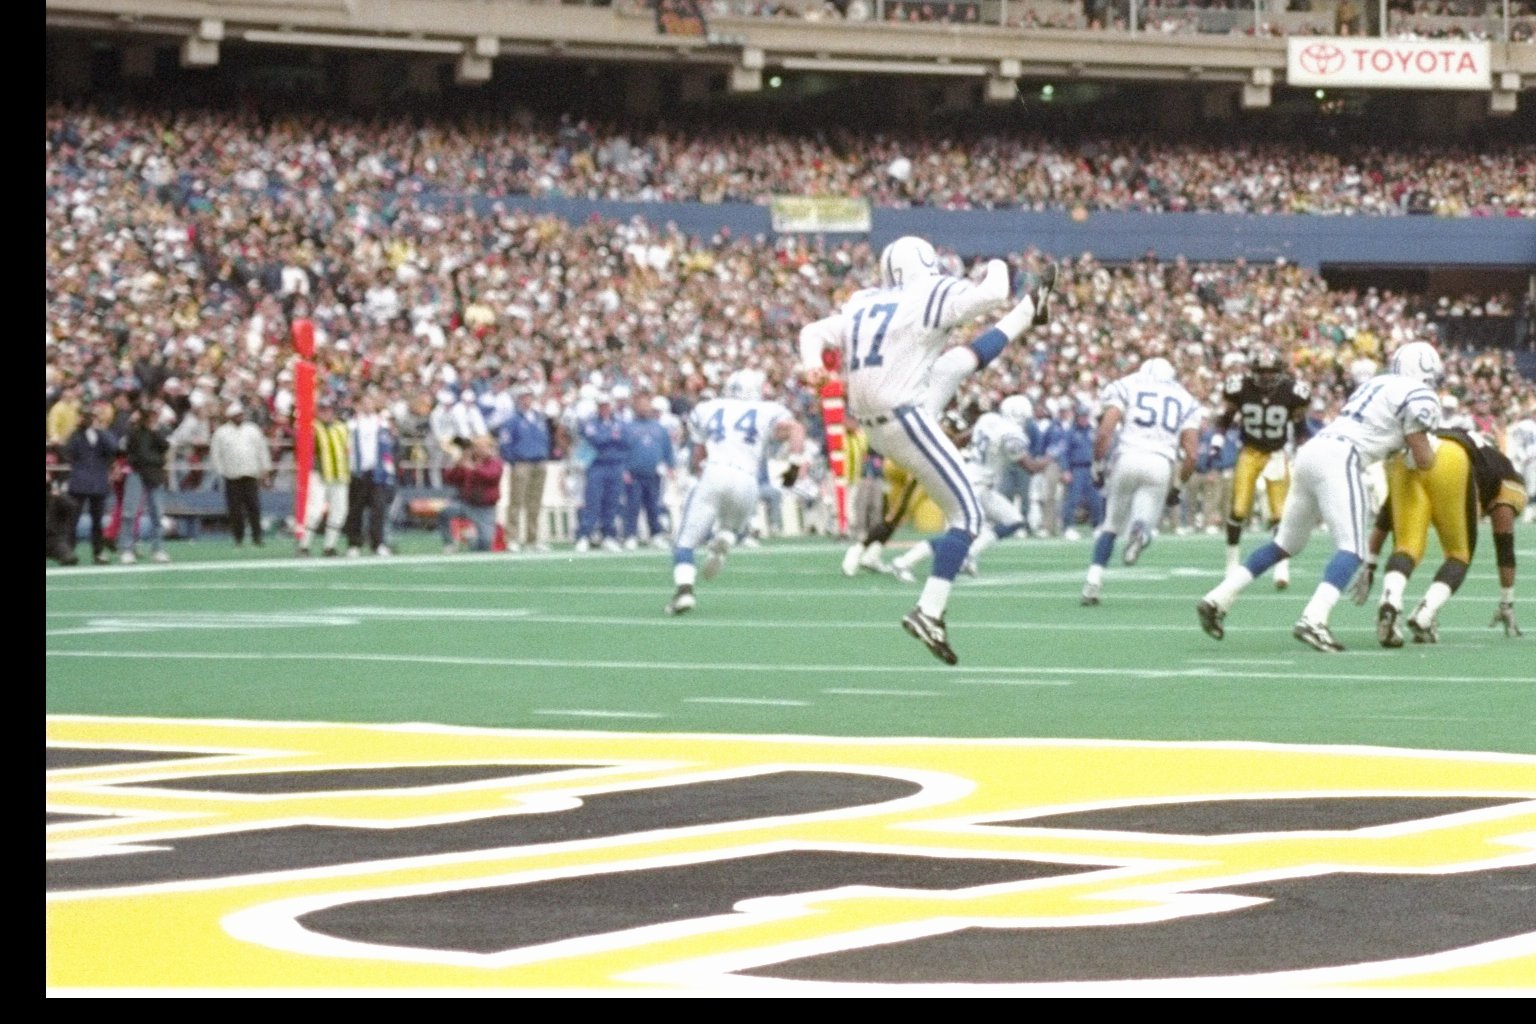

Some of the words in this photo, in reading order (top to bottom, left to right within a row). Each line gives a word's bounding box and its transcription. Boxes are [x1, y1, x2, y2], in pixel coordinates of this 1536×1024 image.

[1353, 49, 1477, 73] TOYOTA
[850, 302, 899, 372] 17
[706, 407, 758, 445] 44
[1134, 391, 1182, 433] 50
[1241, 403, 1288, 439] 29
